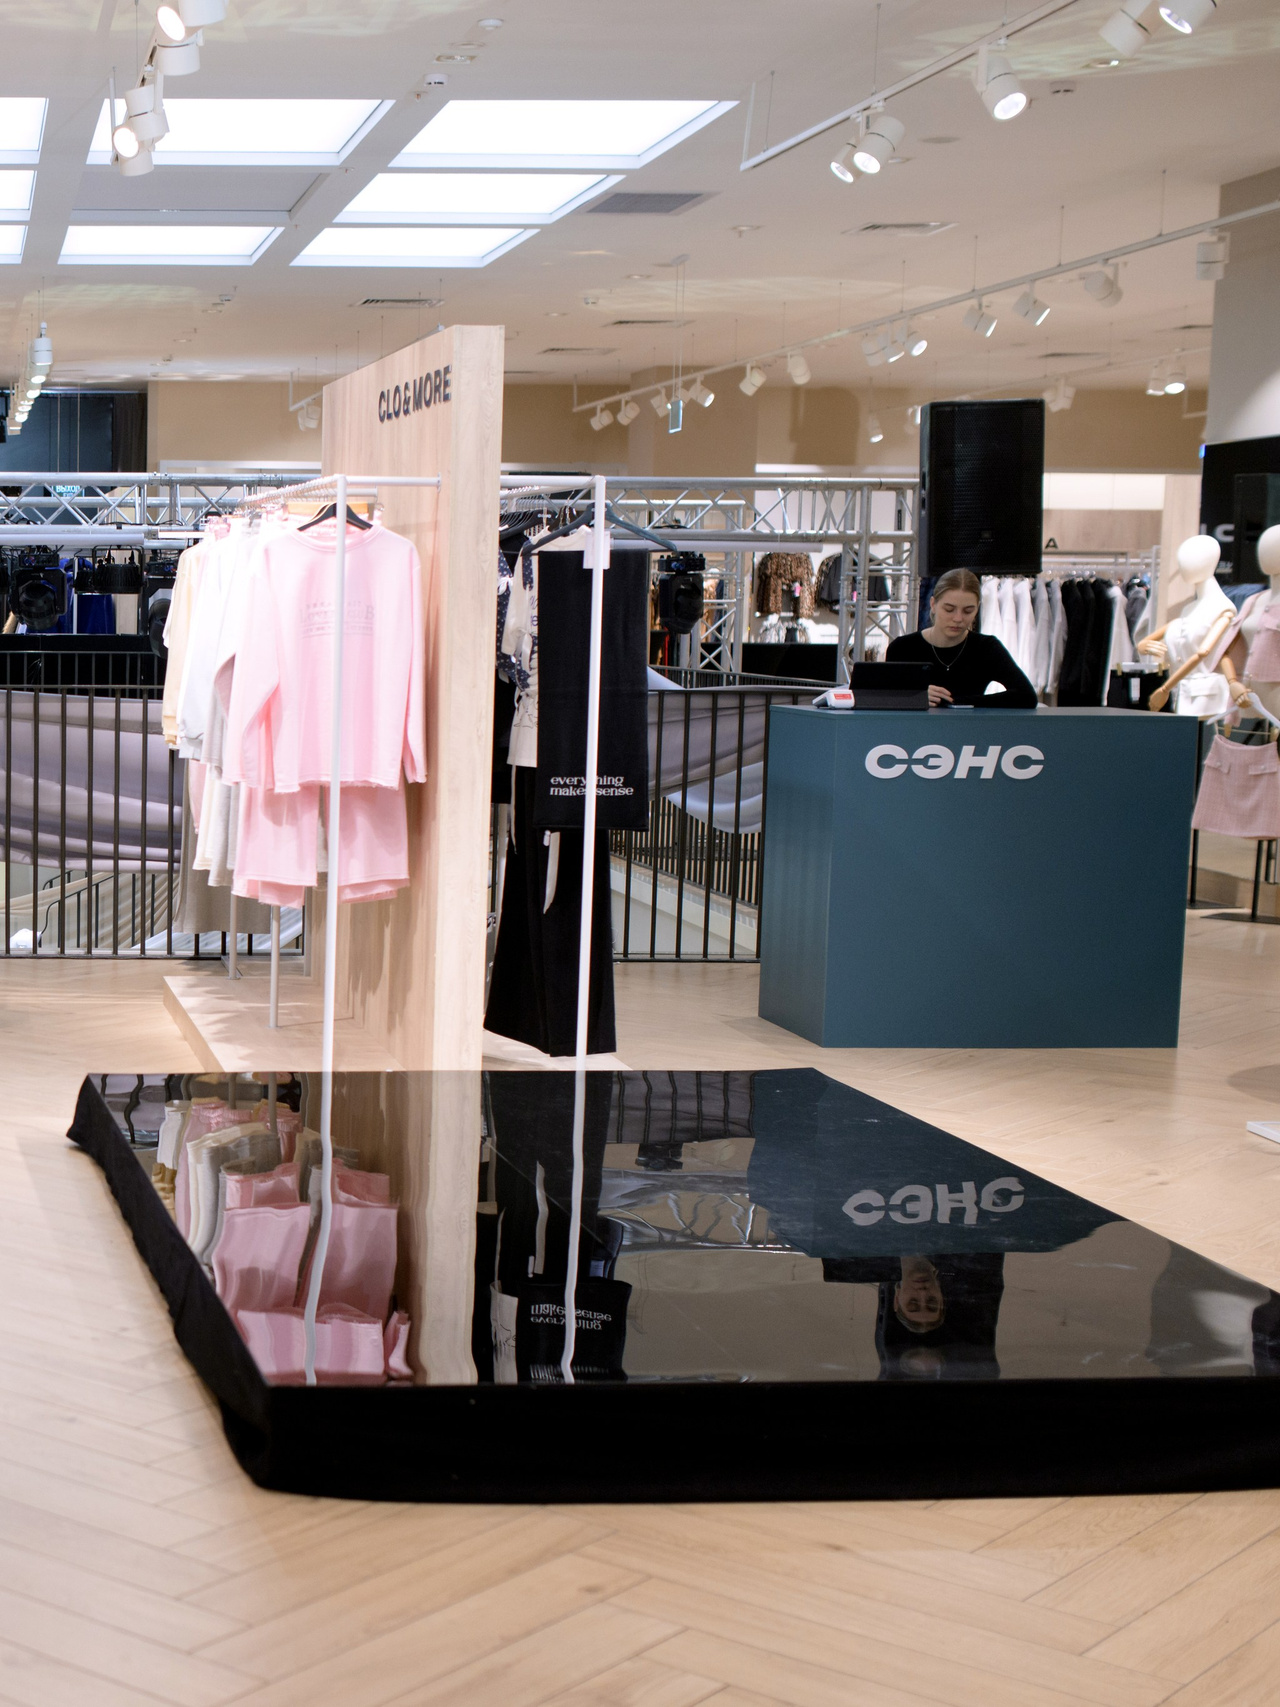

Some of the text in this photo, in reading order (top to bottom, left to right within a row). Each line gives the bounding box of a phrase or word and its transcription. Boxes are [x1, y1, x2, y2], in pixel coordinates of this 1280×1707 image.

[378, 364, 452, 423] CLO&MORE
[865, 744, 1045, 780] СЭНС
[549, 786, 634, 796] make sense
[550, 775, 625, 787] everyhing
